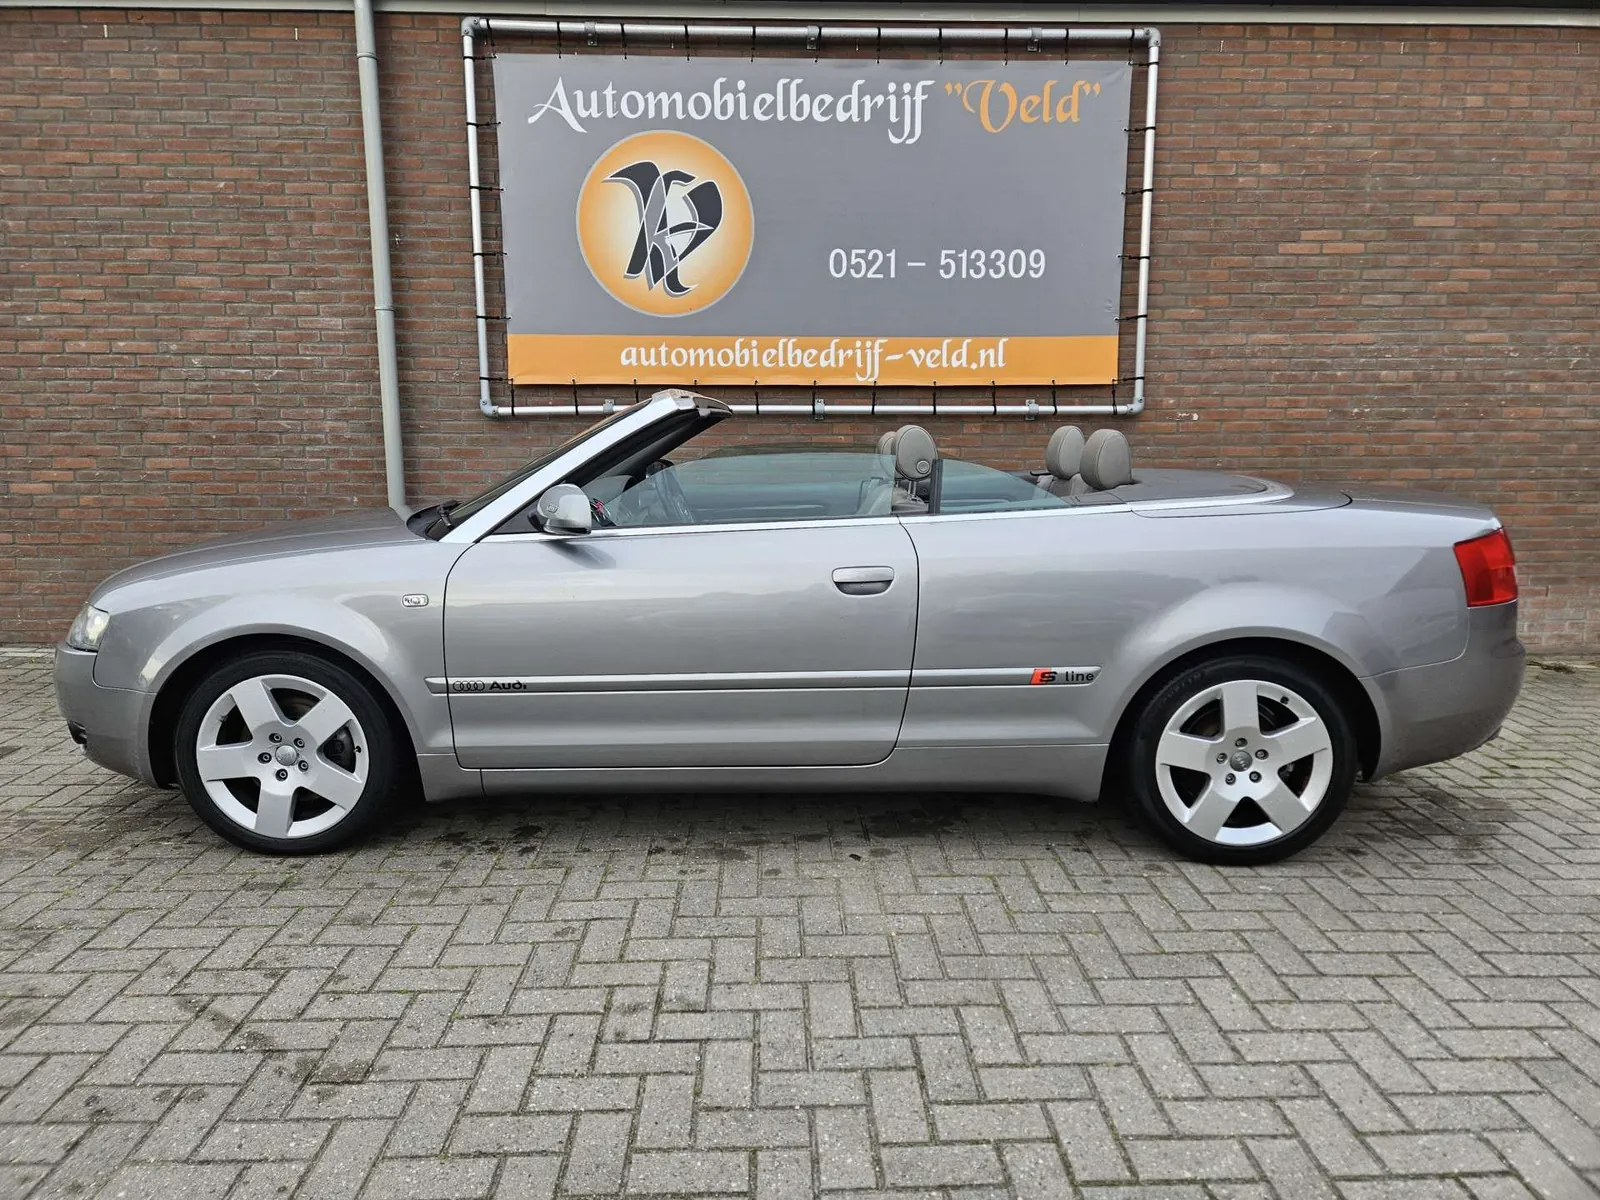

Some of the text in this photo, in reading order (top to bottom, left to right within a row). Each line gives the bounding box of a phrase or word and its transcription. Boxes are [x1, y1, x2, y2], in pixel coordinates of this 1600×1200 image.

[528, 76, 935, 144] Automobielbedrijf
[829, 248, 897, 279] 0521
[939, 248, 1046, 279] 513309
[620, 338, 1007, 381] automobielbedrijf-veld.nl
[489, 680, 527, 690] Audi
[1065, 671, 1095, 682] line
